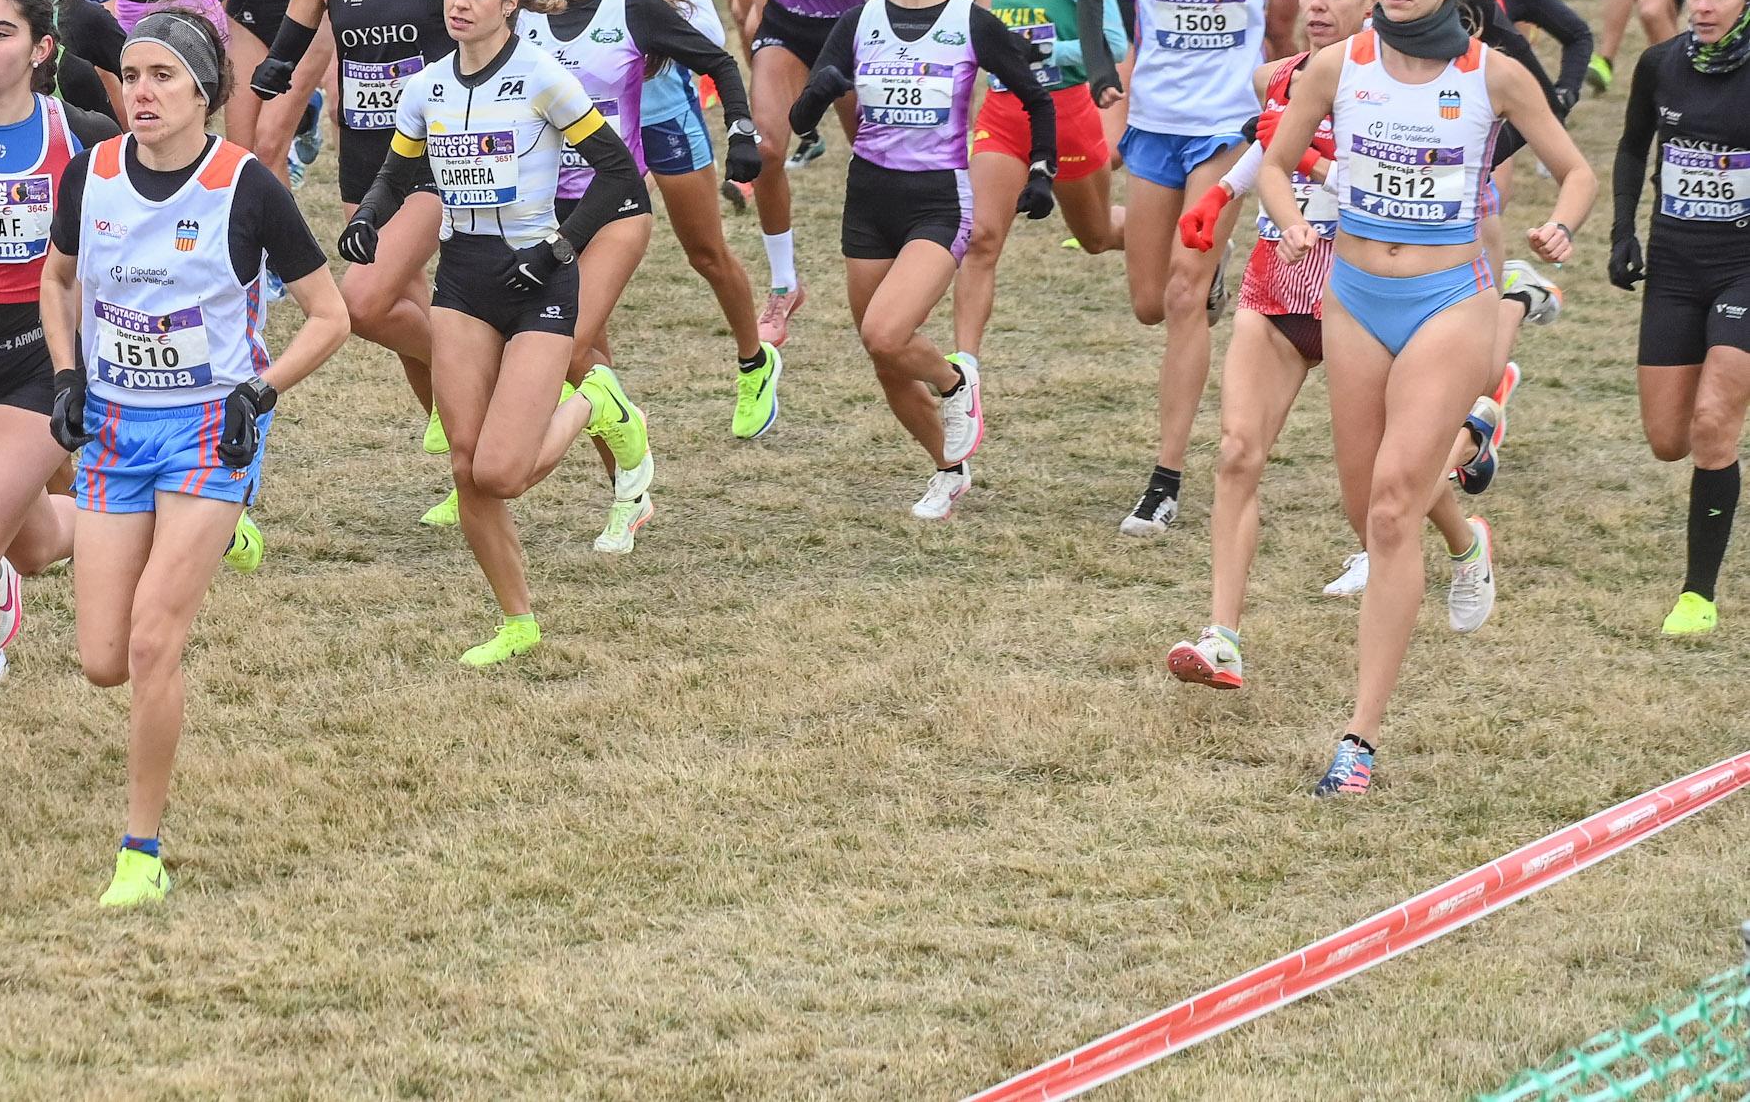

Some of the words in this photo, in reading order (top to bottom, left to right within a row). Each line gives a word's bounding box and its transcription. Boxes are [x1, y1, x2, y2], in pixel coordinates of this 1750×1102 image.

[1174, 14, 1226, 31] 1509
[342, 24, 418, 48] OYSHO
[1182, 33, 1235, 49] Joma
[359, 80, 386, 89] Ibercaja
[498, 80, 523, 97] PA
[882, 77, 912, 85] Ibercaja
[883, 87, 922, 105] 738
[885, 108, 939, 124] Joma
[1392, 122, 1434, 133] Diputació
[428, 135, 478, 146] IPUTACIÓN
[1362, 138, 1417, 156] DIPUTACIÓN
[1391, 133, 1401, 141] de
[1404, 133, 1441, 144] València
[1361, 147, 1417, 164] BURGOS
[441, 168, 495, 186] CARRERA
[1378, 162, 1414, 175] Ibercaja
[1373, 172, 1436, 199] 1512
[1678, 178, 1735, 199] 2436
[452, 190, 498, 205] Joma
[27, 204, 48, 213] 3645
[1378, 197, 1446, 221] Joma
[1687, 200, 1744, 217] Joma
[13, 218, 23, 237] F.
[130, 266, 168, 276] Diputació
[143, 276, 174, 285] València
[102, 303, 149, 323] DIPUTACIÓN
[104, 311, 150, 332] BURGOS
[116, 328, 152, 343] Ibercaja
[114, 341, 180, 368] 1510
[123, 368, 196, 388] Joma
